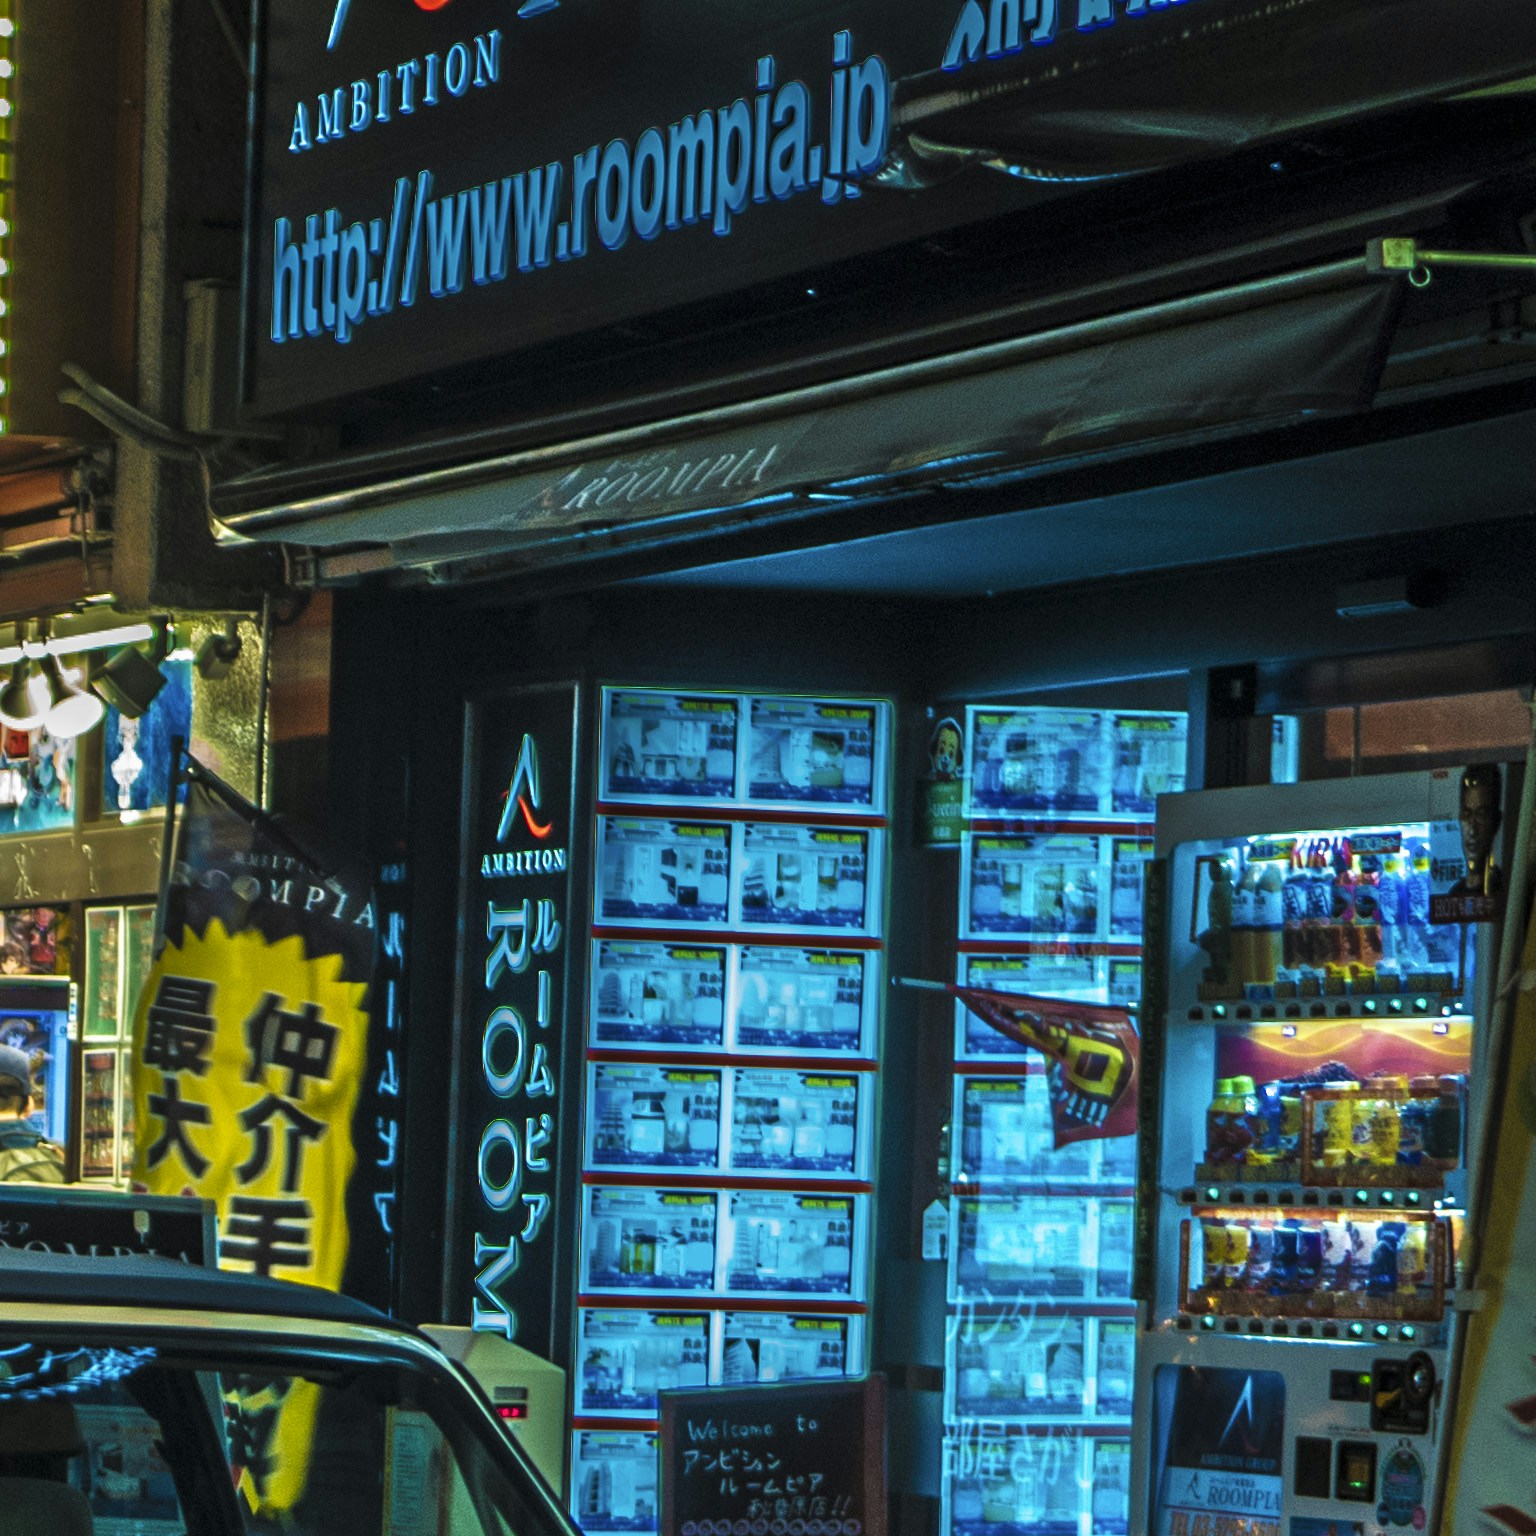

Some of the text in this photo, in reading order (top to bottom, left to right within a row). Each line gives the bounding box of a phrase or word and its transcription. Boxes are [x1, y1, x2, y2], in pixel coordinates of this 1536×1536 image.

[270, 29, 893, 343] http://www.roompia.jp
[287, 29, 503, 153] AMBITION
[481, 848, 568, 878] AMBITION
[140, 973, 220, 1182] 最大
[220, 990, 341, 1277] 仲介手
[522, 898, 563, 1243] ルームピア
[688, 1413, 819, 1442] Welcome to
